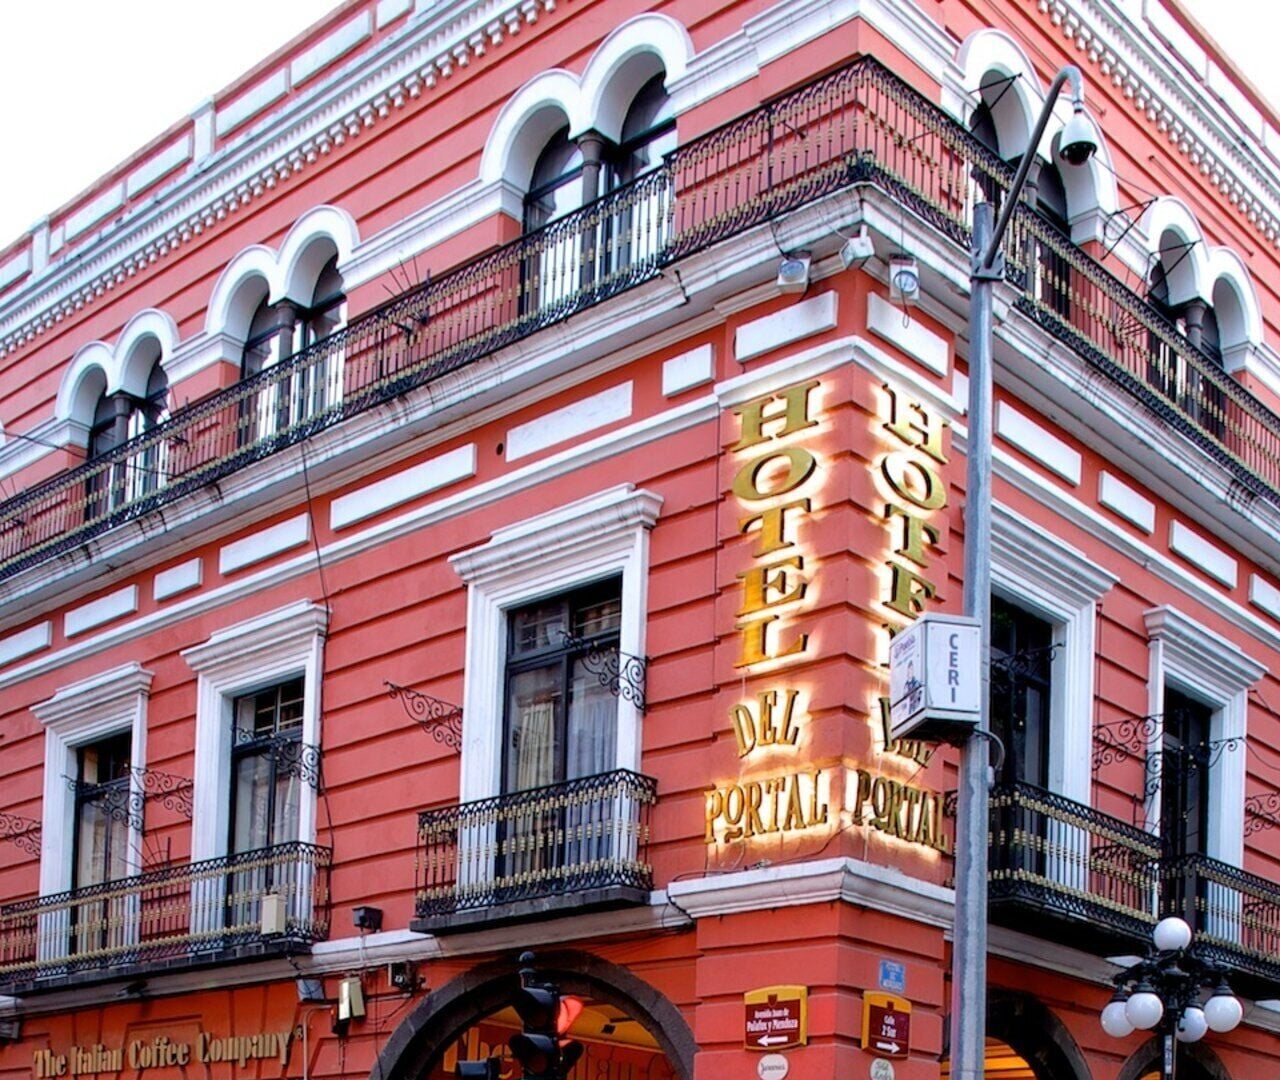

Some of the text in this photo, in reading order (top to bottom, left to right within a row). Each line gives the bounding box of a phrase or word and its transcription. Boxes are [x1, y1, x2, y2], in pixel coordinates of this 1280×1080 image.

[732, 380, 821, 669] HOTEL
[880, 383, 951, 668] HOTE
[948, 633, 960, 704] CERI
[729, 688, 799, 759] DEL
[704, 769, 828, 844] PORTAL
[853, 768, 948, 852] PORTAL
[34, 1030, 291, 1079] The Italian Coffee Company
